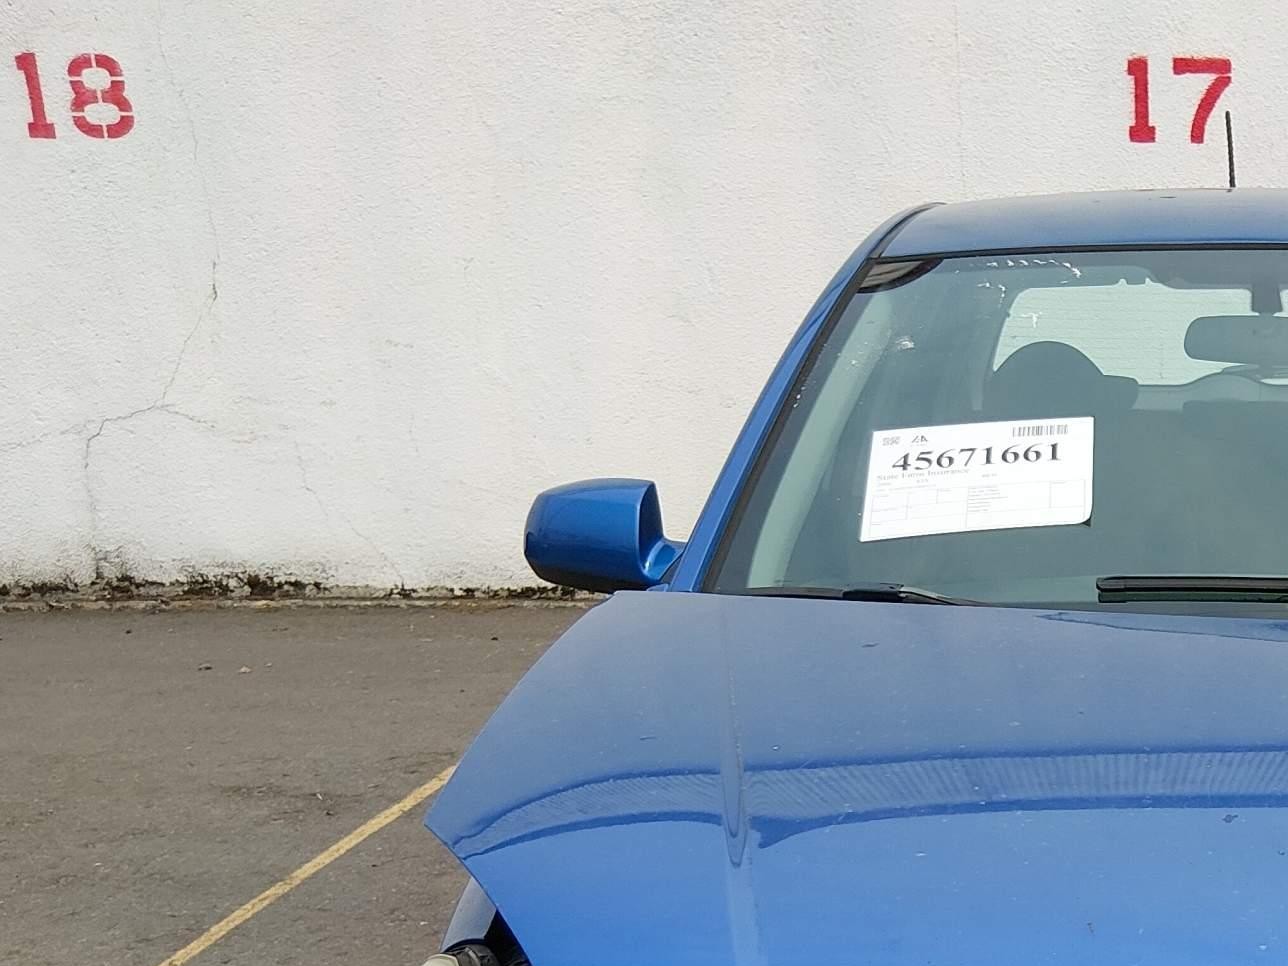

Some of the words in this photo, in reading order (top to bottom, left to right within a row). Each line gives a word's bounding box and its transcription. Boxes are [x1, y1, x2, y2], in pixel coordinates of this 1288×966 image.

[15, 52, 135, 139] 18
[1126, 56, 1233, 144] 17
[891, 442, 1062, 471] 45671661
